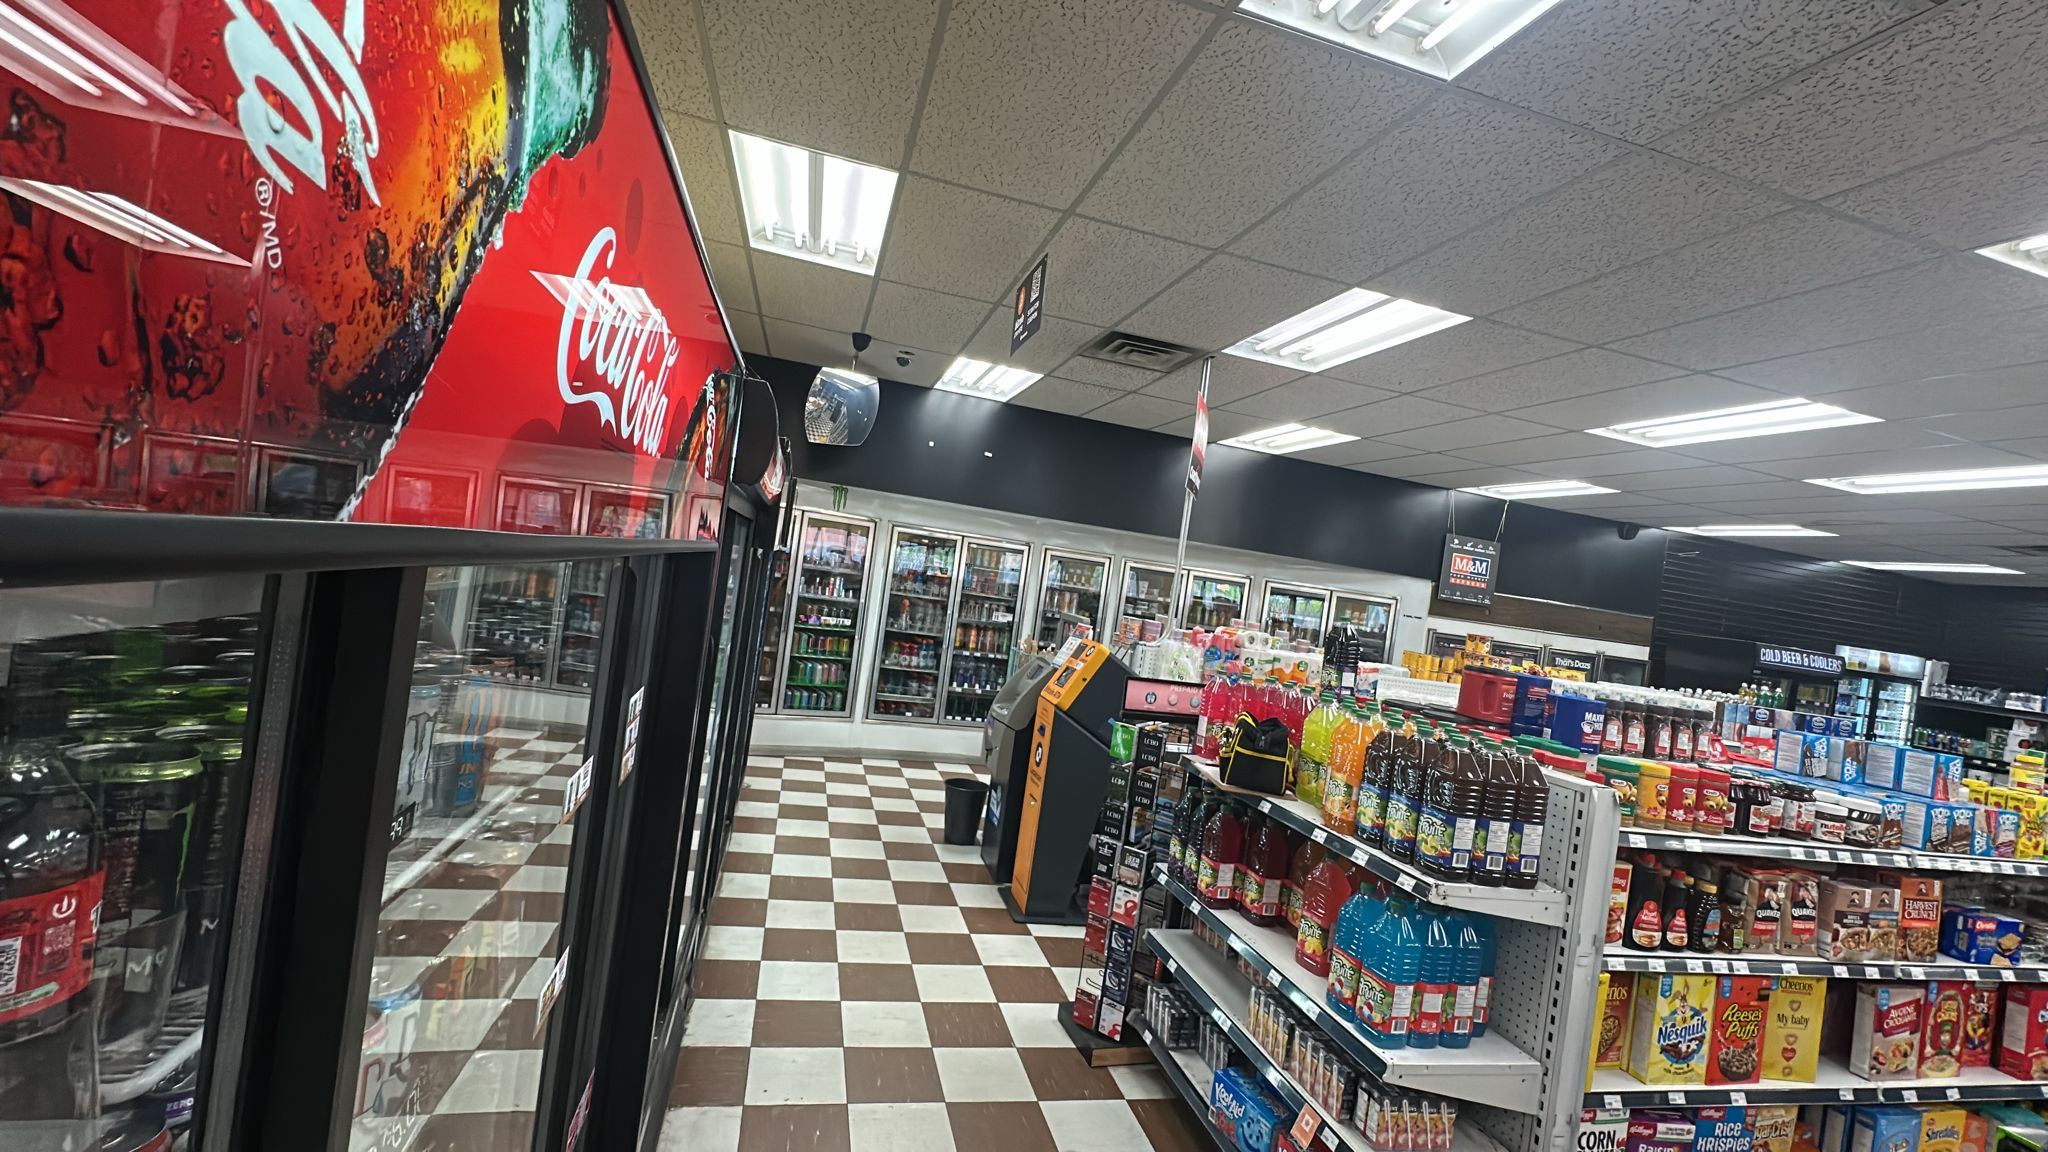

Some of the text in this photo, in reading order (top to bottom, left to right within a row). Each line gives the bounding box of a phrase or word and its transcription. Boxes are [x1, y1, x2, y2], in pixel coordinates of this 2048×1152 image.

[1454, 557, 1487, 574] M&M
[1760, 648, 1780, 662] COLD
[1781, 650, 1802, 665] BEER
[1810, 655, 1842, 672] COOLERS
[1905, 900, 1938, 910] HARVEST
[1904, 909, 1936, 921] CRUNCH
[1722, 1003, 1763, 1022] Reese's
[1888, 1003, 1916, 1019] AVOINE
[1657, 1015, 1707, 1046] Nesquik
[1725, 1021, 1759, 1040] Puffs
[1776, 1013, 1810, 1029] My baby
[1215, 1082, 1246, 1119] Kool-Aid
[1577, 1130, 1616, 1151] CORN
